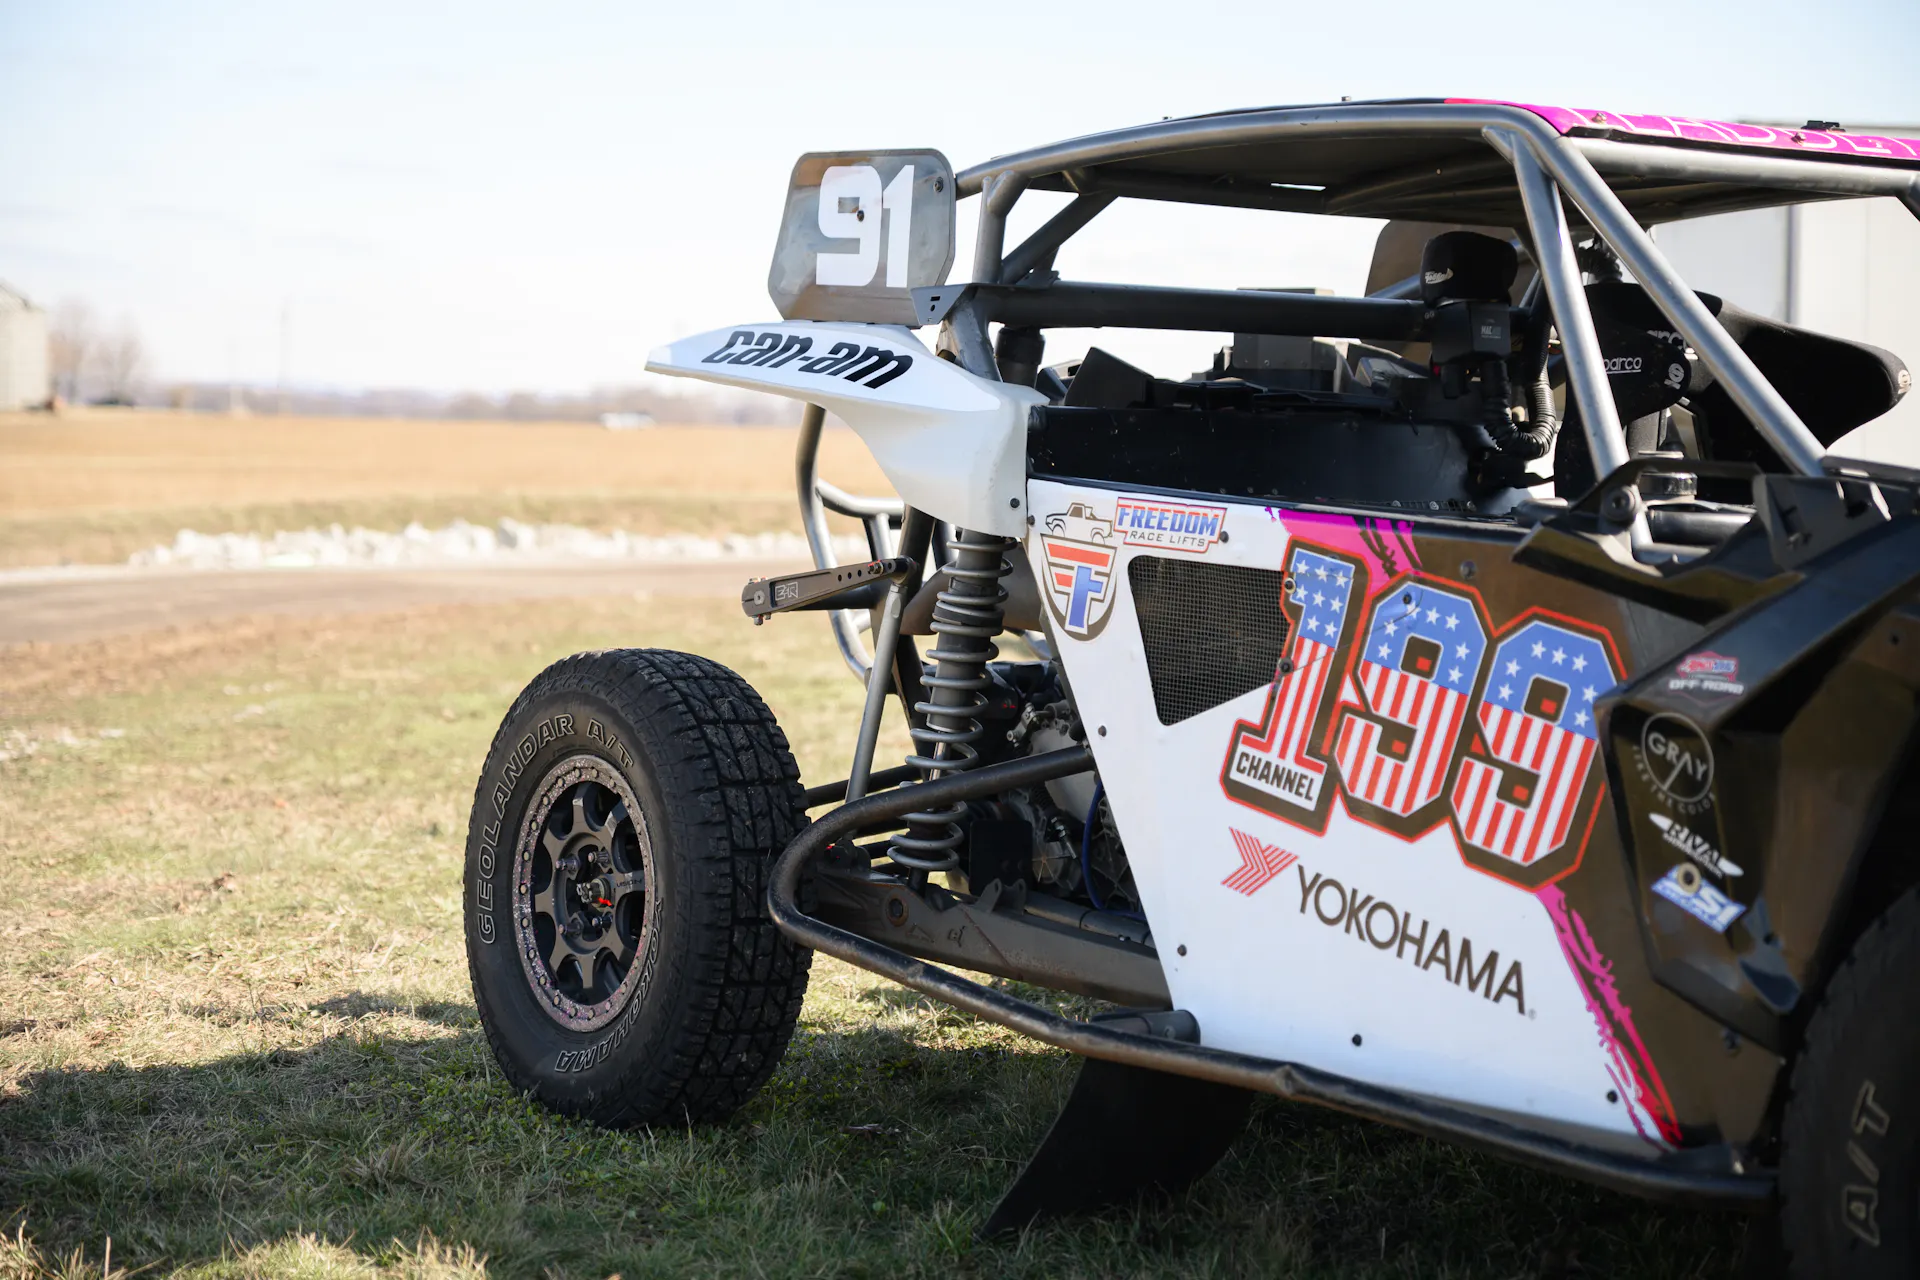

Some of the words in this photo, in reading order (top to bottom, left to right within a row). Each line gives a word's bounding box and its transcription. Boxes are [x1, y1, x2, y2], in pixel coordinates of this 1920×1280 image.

[815, 165, 915, 288] 91
[701, 329, 913, 389] can-am
[1117, 503, 1221, 537] FREEDOM
[1129, 530, 1164, 543] RACE
[1169, 534, 1206, 548] LIFTS
[1223, 545, 1624, 886] 199
[1648, 731, 1708, 790] GRAY
[1235, 751, 1315, 801] CHANNEL
[478, 713, 574, 946] GEOLANDAR
[587, 717, 634, 768] A/T
[1298, 864, 1526, 1015] YOKOHAMA
[1663, 868, 1738, 924] SI
[553, 896, 664, 1074] YOKOHAMA
[1841, 1078, 1892, 1249] A/T
